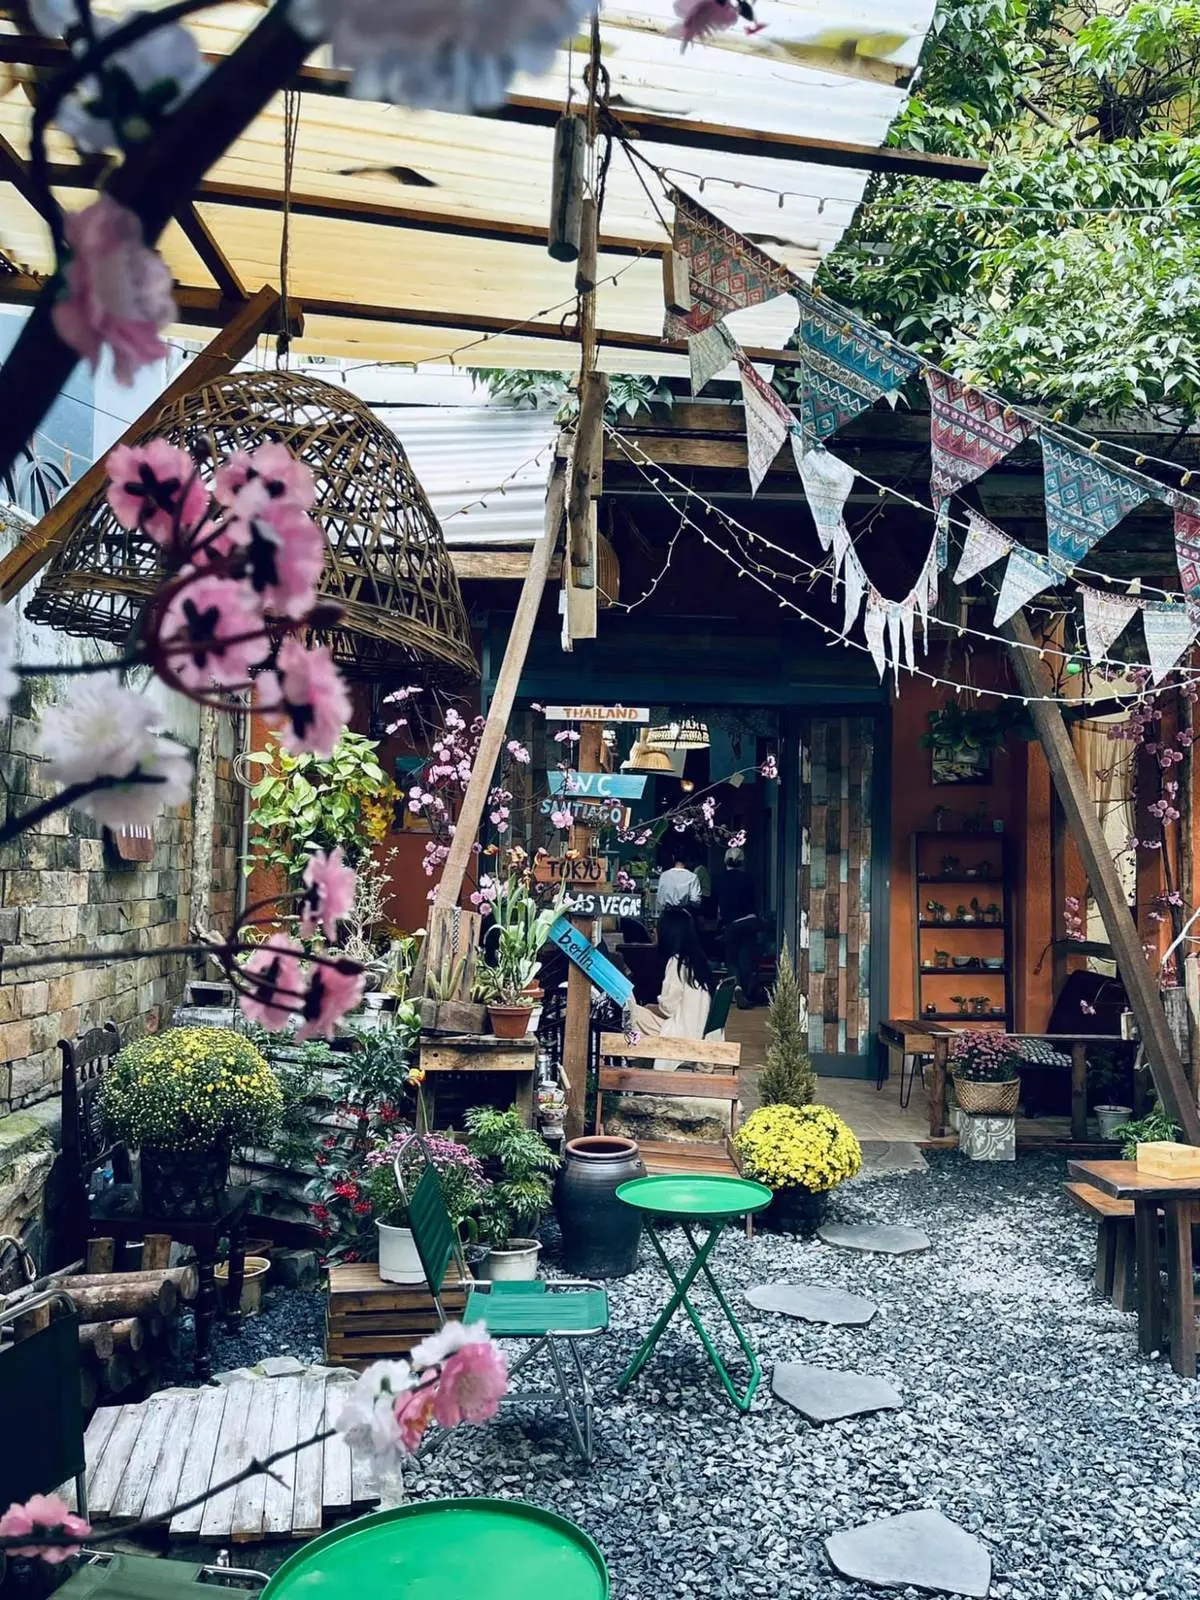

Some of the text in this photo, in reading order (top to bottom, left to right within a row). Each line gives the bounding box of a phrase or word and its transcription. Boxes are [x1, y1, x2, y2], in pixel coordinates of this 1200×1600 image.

[563, 707, 638, 720] THAILAND
[547, 860, 602, 881] TOKYO
[558, 927, 595, 971] berlin
